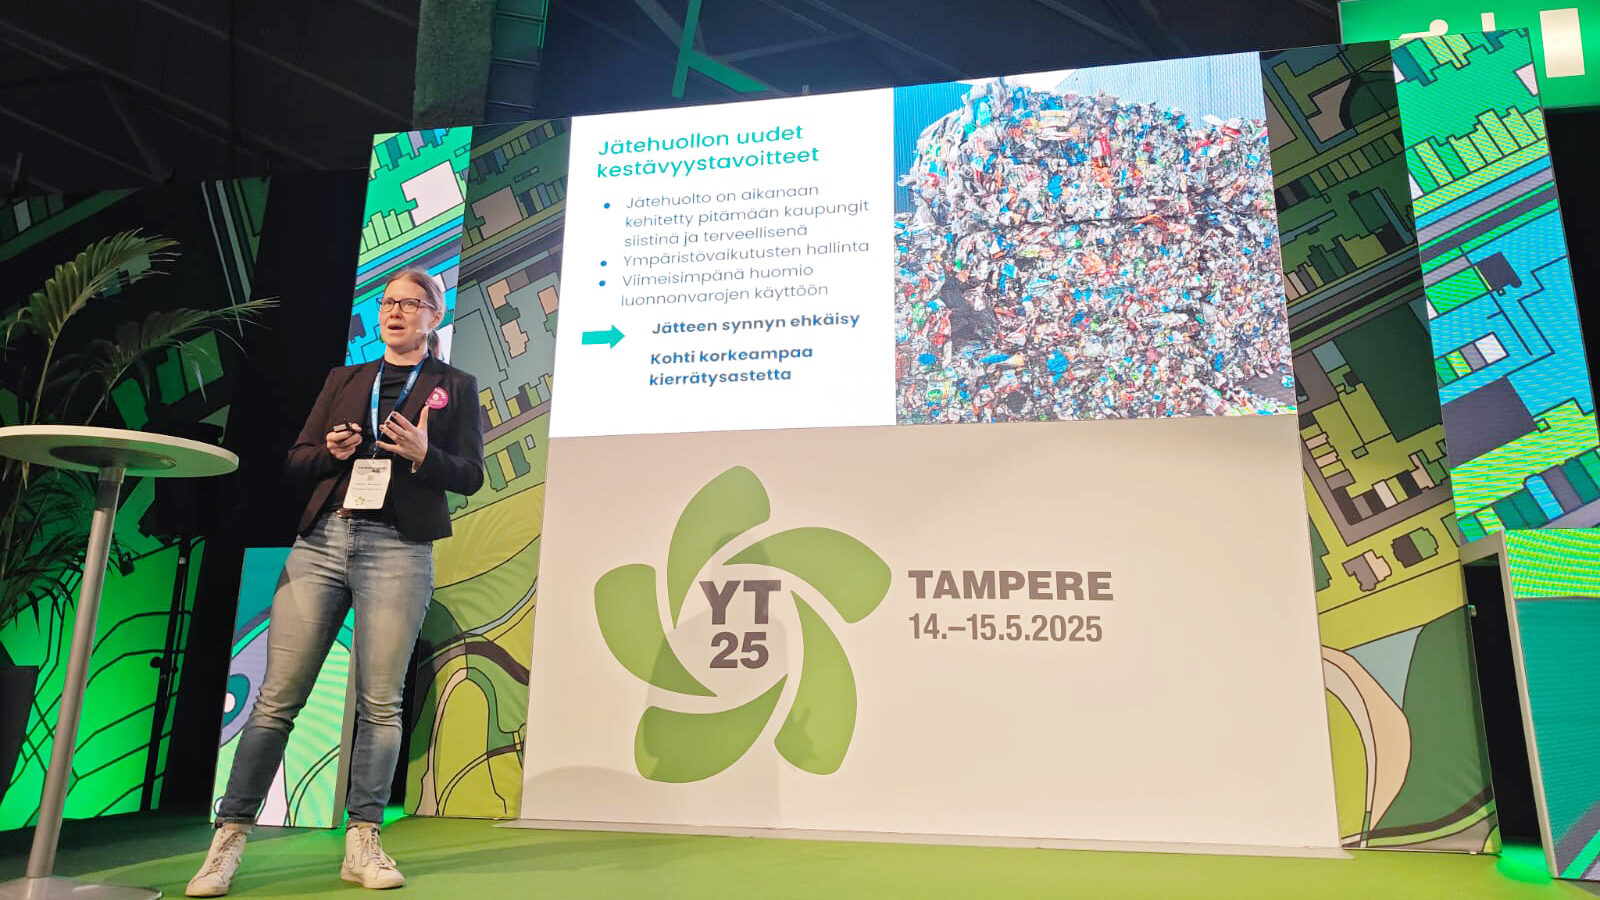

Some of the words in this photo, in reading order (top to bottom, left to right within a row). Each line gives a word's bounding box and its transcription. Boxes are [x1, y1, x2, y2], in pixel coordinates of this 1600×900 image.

[598, 132, 729, 156] Jätehuollon
[737, 125, 804, 145] uudet
[596, 147, 819, 178] kestävyystavoitteet
[625, 191, 712, 209] Jätehuolto
[716, 191, 736, 203] on
[741, 184, 819, 200] aikanaan
[625, 209, 693, 228] kehitetty
[698, 206, 779, 226] pitämään
[784, 200, 870, 218] kaupungit
[624, 231, 679, 247] siistinä
[684, 231, 699, 247] ja
[703, 224, 808, 243] terveellisenä
[623, 244, 802, 268] Ympäristövaikutusten
[806, 241, 870, 256] hallinta
[622, 268, 745, 287] Viimeisimpänä
[749, 265, 814, 278] huomio
[621, 287, 749, 307] luonnonvarojen
[754, 283, 828, 302] käyttöön
[652, 320, 718, 335] Jätteen
[722, 316, 786, 334] synnyn
[790, 312, 860, 327] ehkäisy
[651, 351, 695, 365] Kohti
[699, 347, 813, 362] korkeampaa
[649, 369, 792, 387] kierrätysastetta
[908, 570, 1113, 600] TAMPERE
[699, 580, 781, 625] YT
[709, 631, 769, 669] 25
